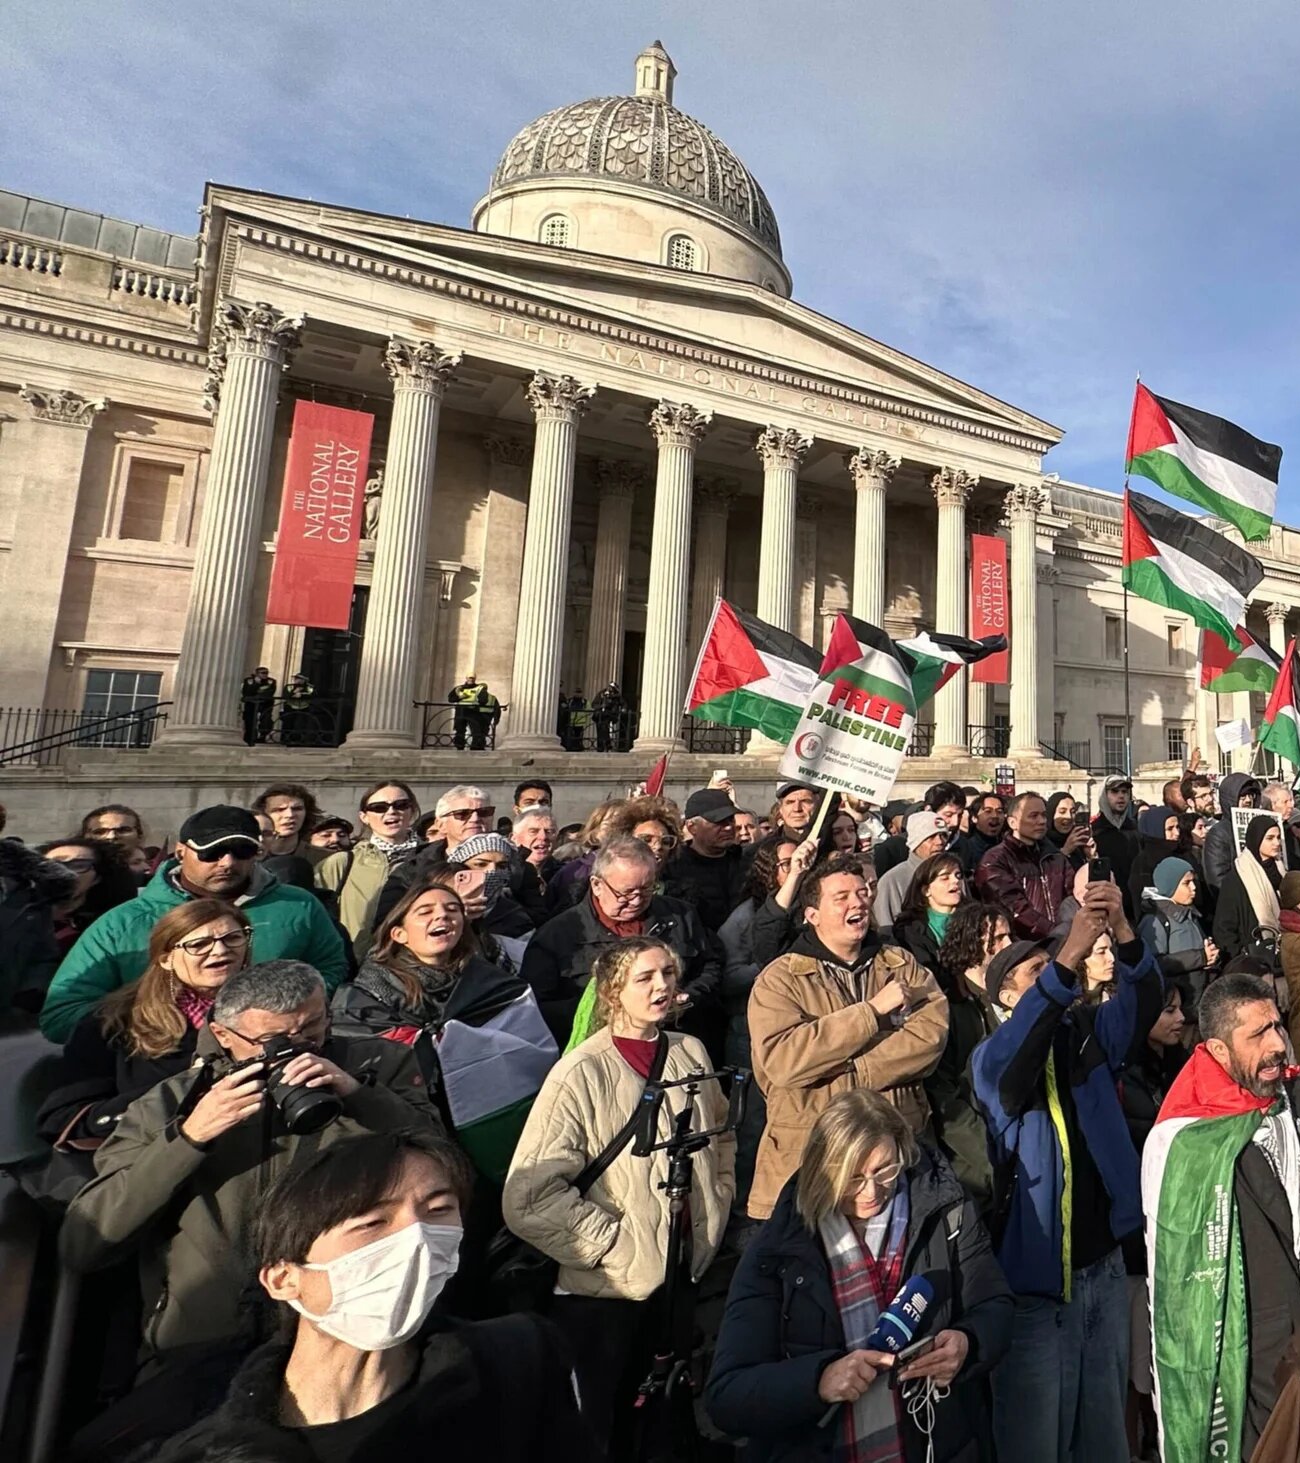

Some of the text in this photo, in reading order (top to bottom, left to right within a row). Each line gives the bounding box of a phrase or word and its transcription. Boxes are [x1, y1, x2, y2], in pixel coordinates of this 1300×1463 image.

[491, 313, 927, 438] THE NATIONAL GALLERY
[293, 490, 306, 511] THE
[303, 439, 335, 541] NATIONAL
[327, 441, 360, 544] GALLERY
[981, 558, 993, 627] NATIONAL
[992, 560, 1005, 628] GALLERY
[806, 702, 908, 752] PALESTINE
[827, 677, 907, 730] FREE
[797, 765, 877, 797] WWW.PFBUK.COM
